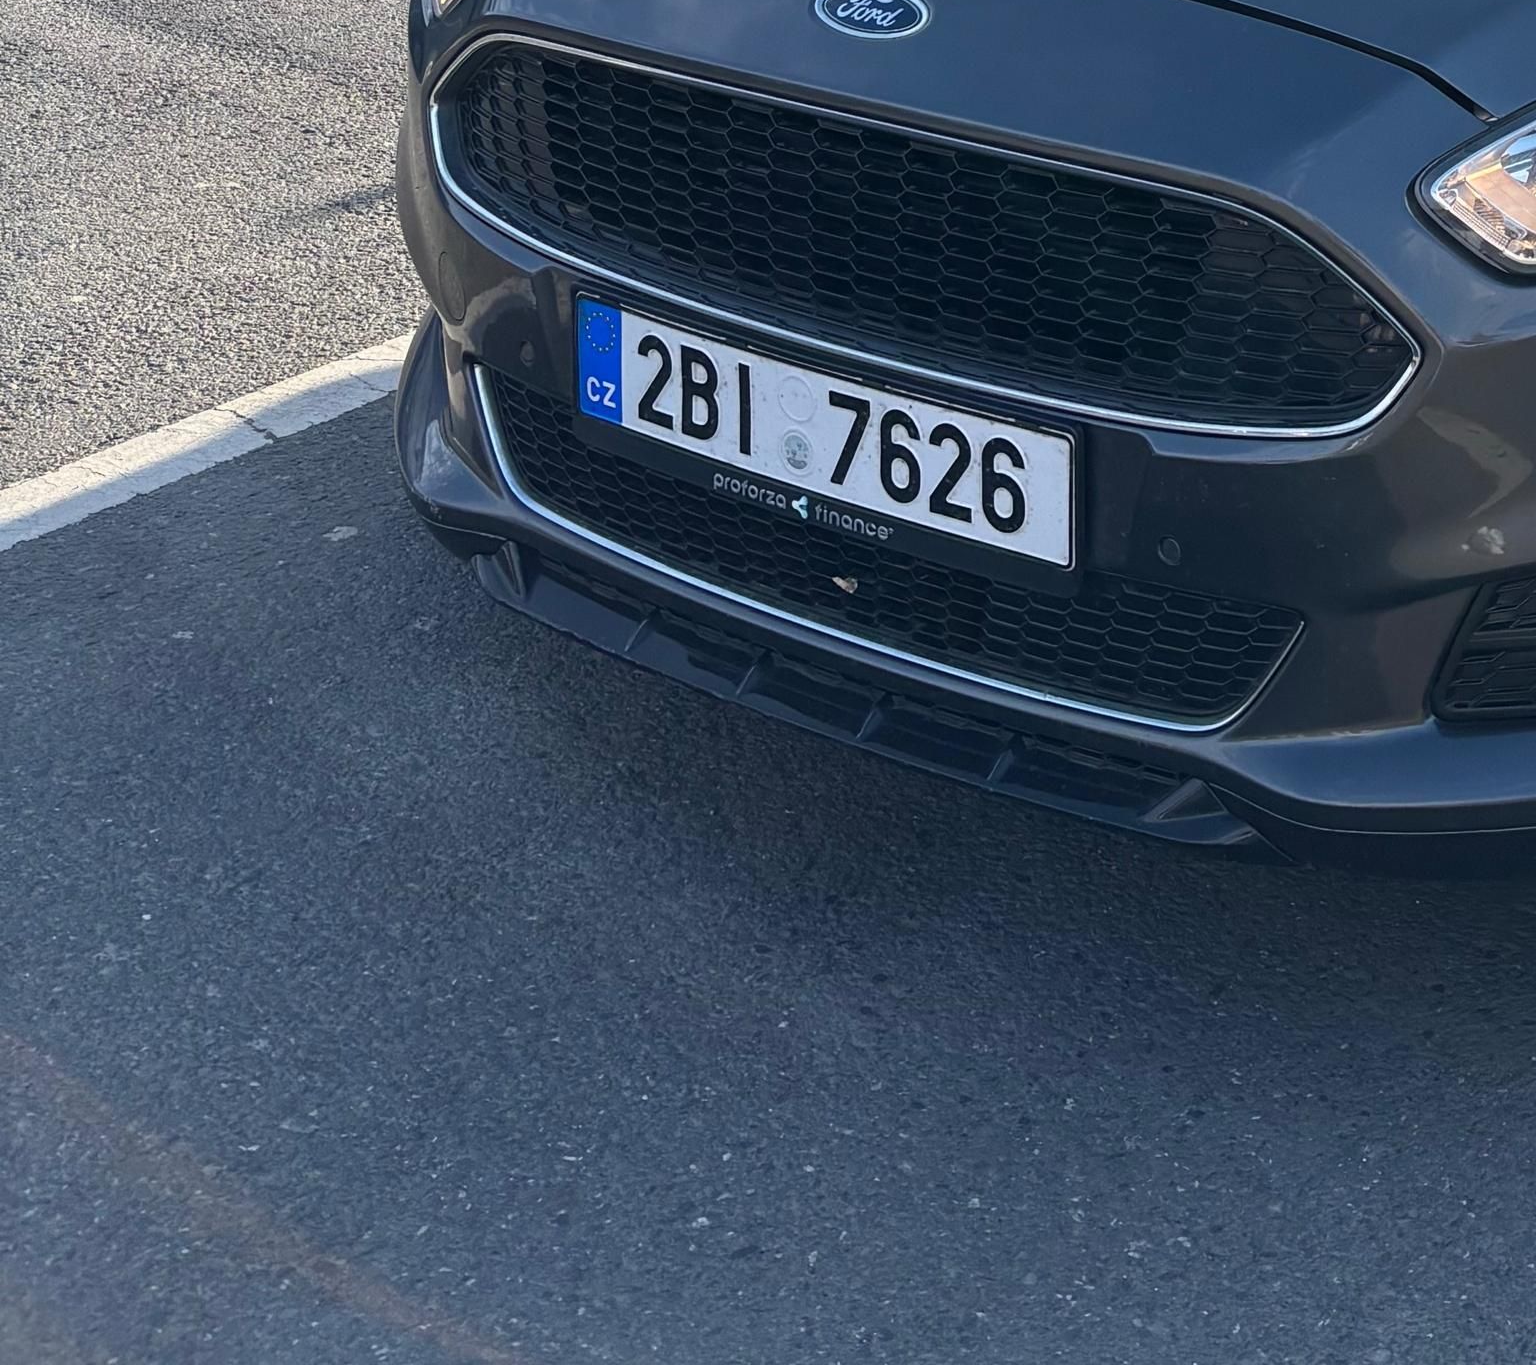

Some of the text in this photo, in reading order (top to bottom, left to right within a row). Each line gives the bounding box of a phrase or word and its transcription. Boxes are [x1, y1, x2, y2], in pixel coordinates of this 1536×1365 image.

[586, 375, 617, 410] CZ
[637, 333, 1027, 534] 2BI 7626
[713, 472, 892, 541] proforza finance
